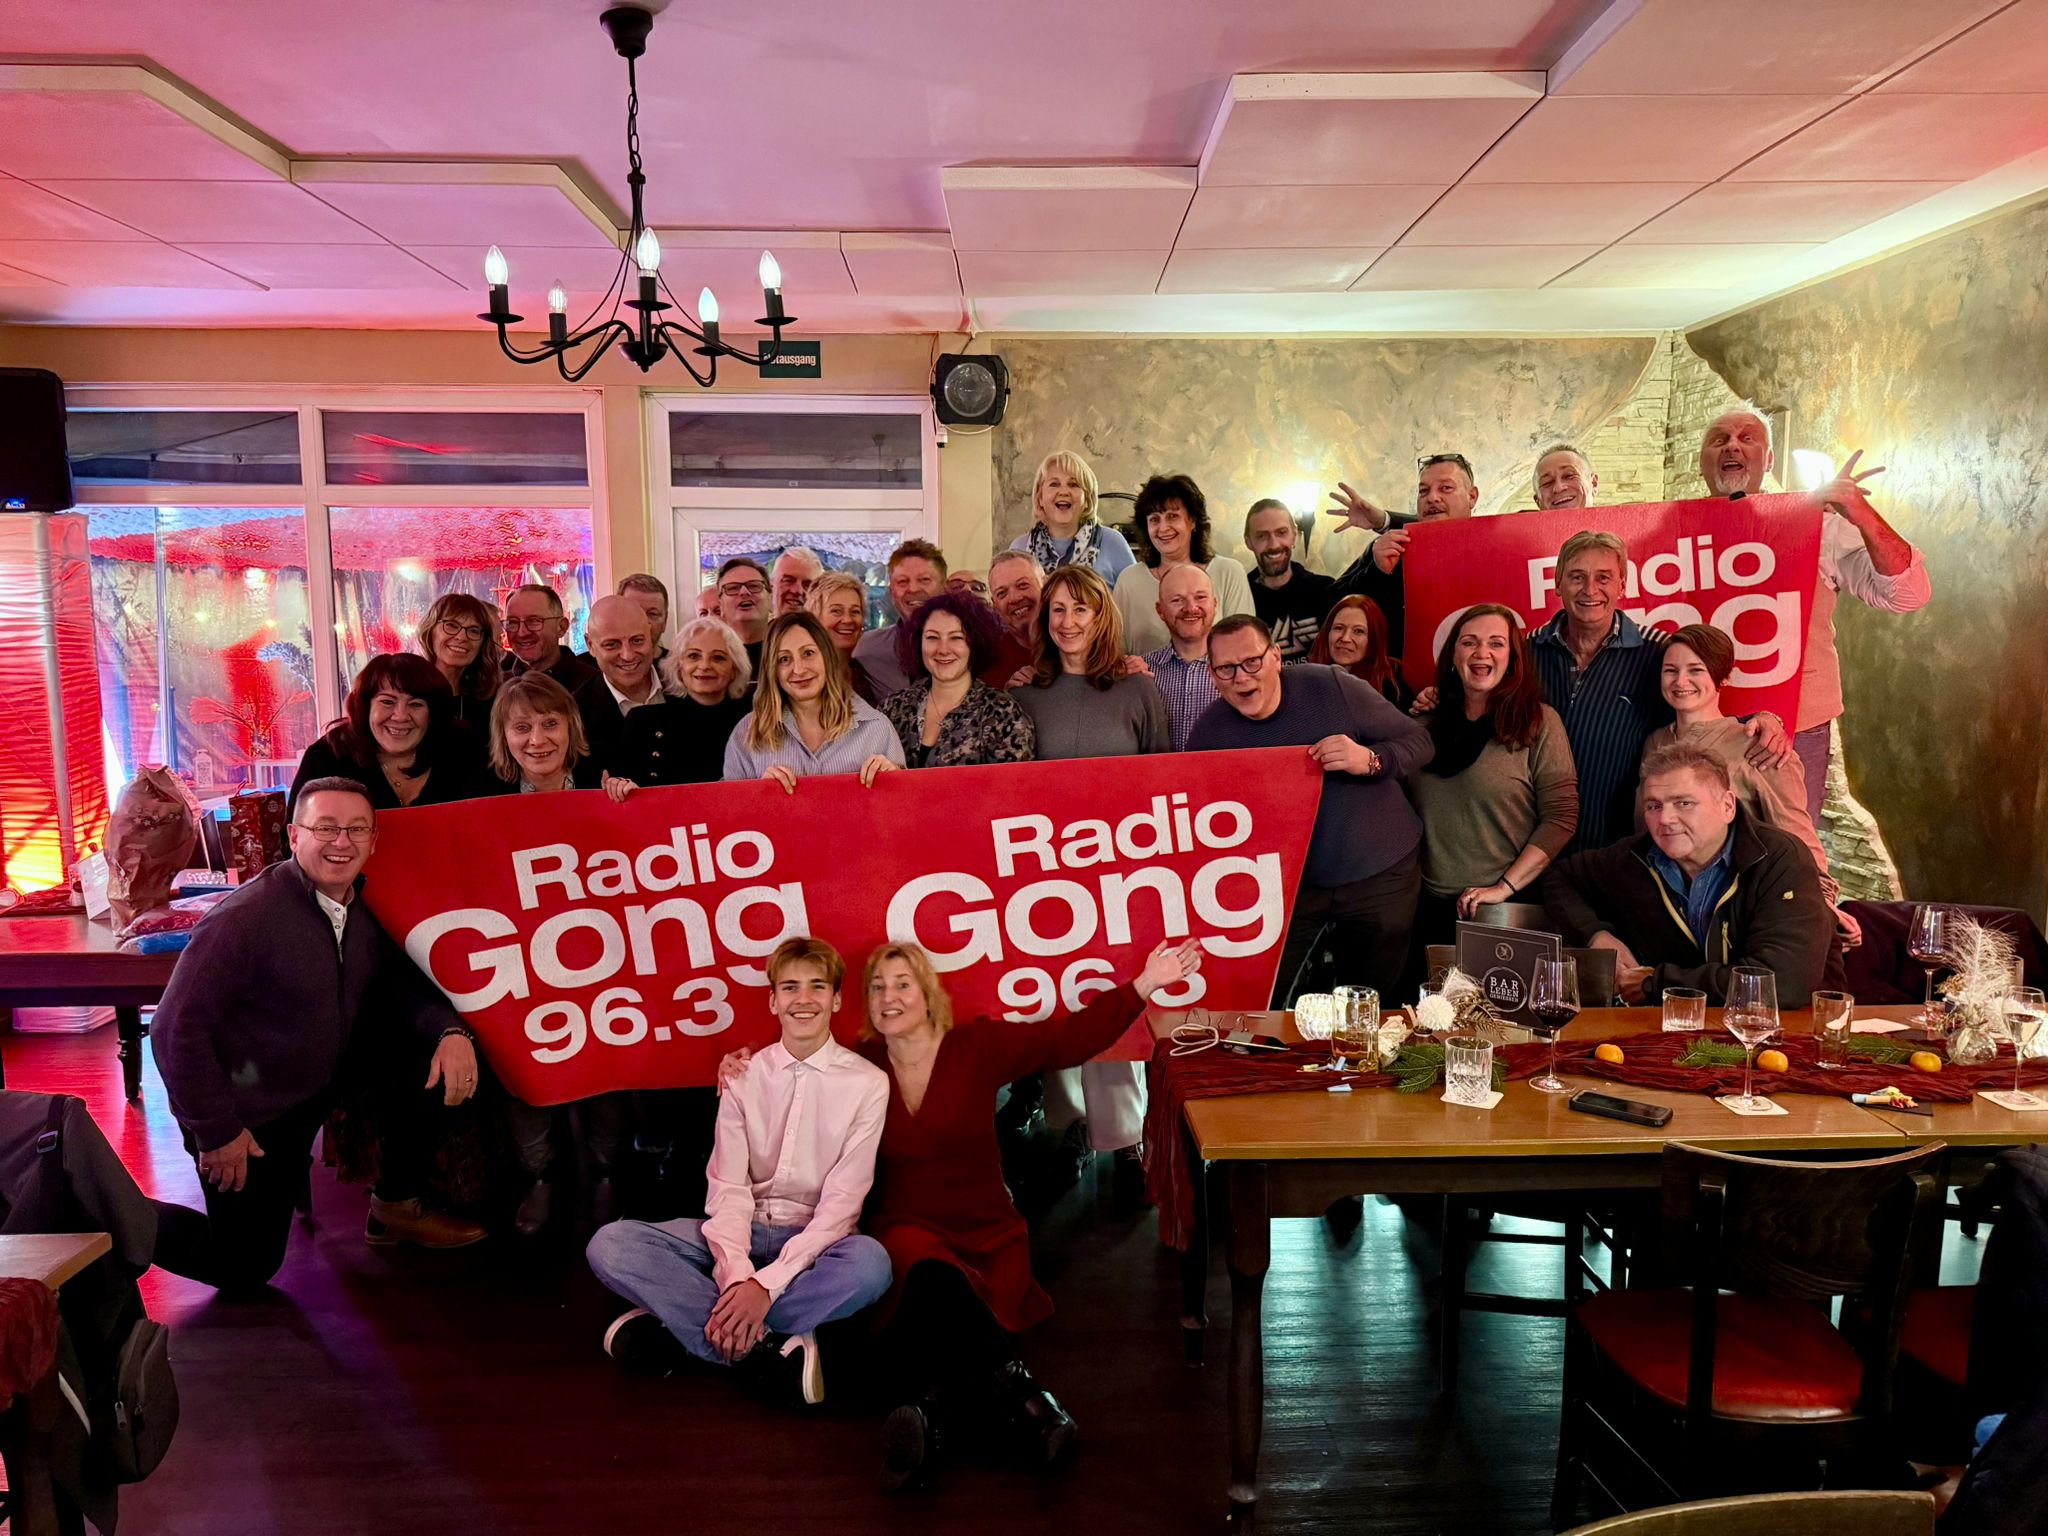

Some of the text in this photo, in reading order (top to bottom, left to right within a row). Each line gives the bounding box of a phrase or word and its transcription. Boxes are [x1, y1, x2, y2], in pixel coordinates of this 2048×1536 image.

[1527, 534, 1776, 610] dio
[512, 823, 775, 910] Radio
[991, 792, 1253, 878] Radio
[404, 881, 811, 1013] Gong
[885, 852, 1285, 973] Gong
[523, 976, 735, 1064] 96.3
[1490, 976, 1519, 990] BAR
[1490, 986, 1519, 998] LEBEN
